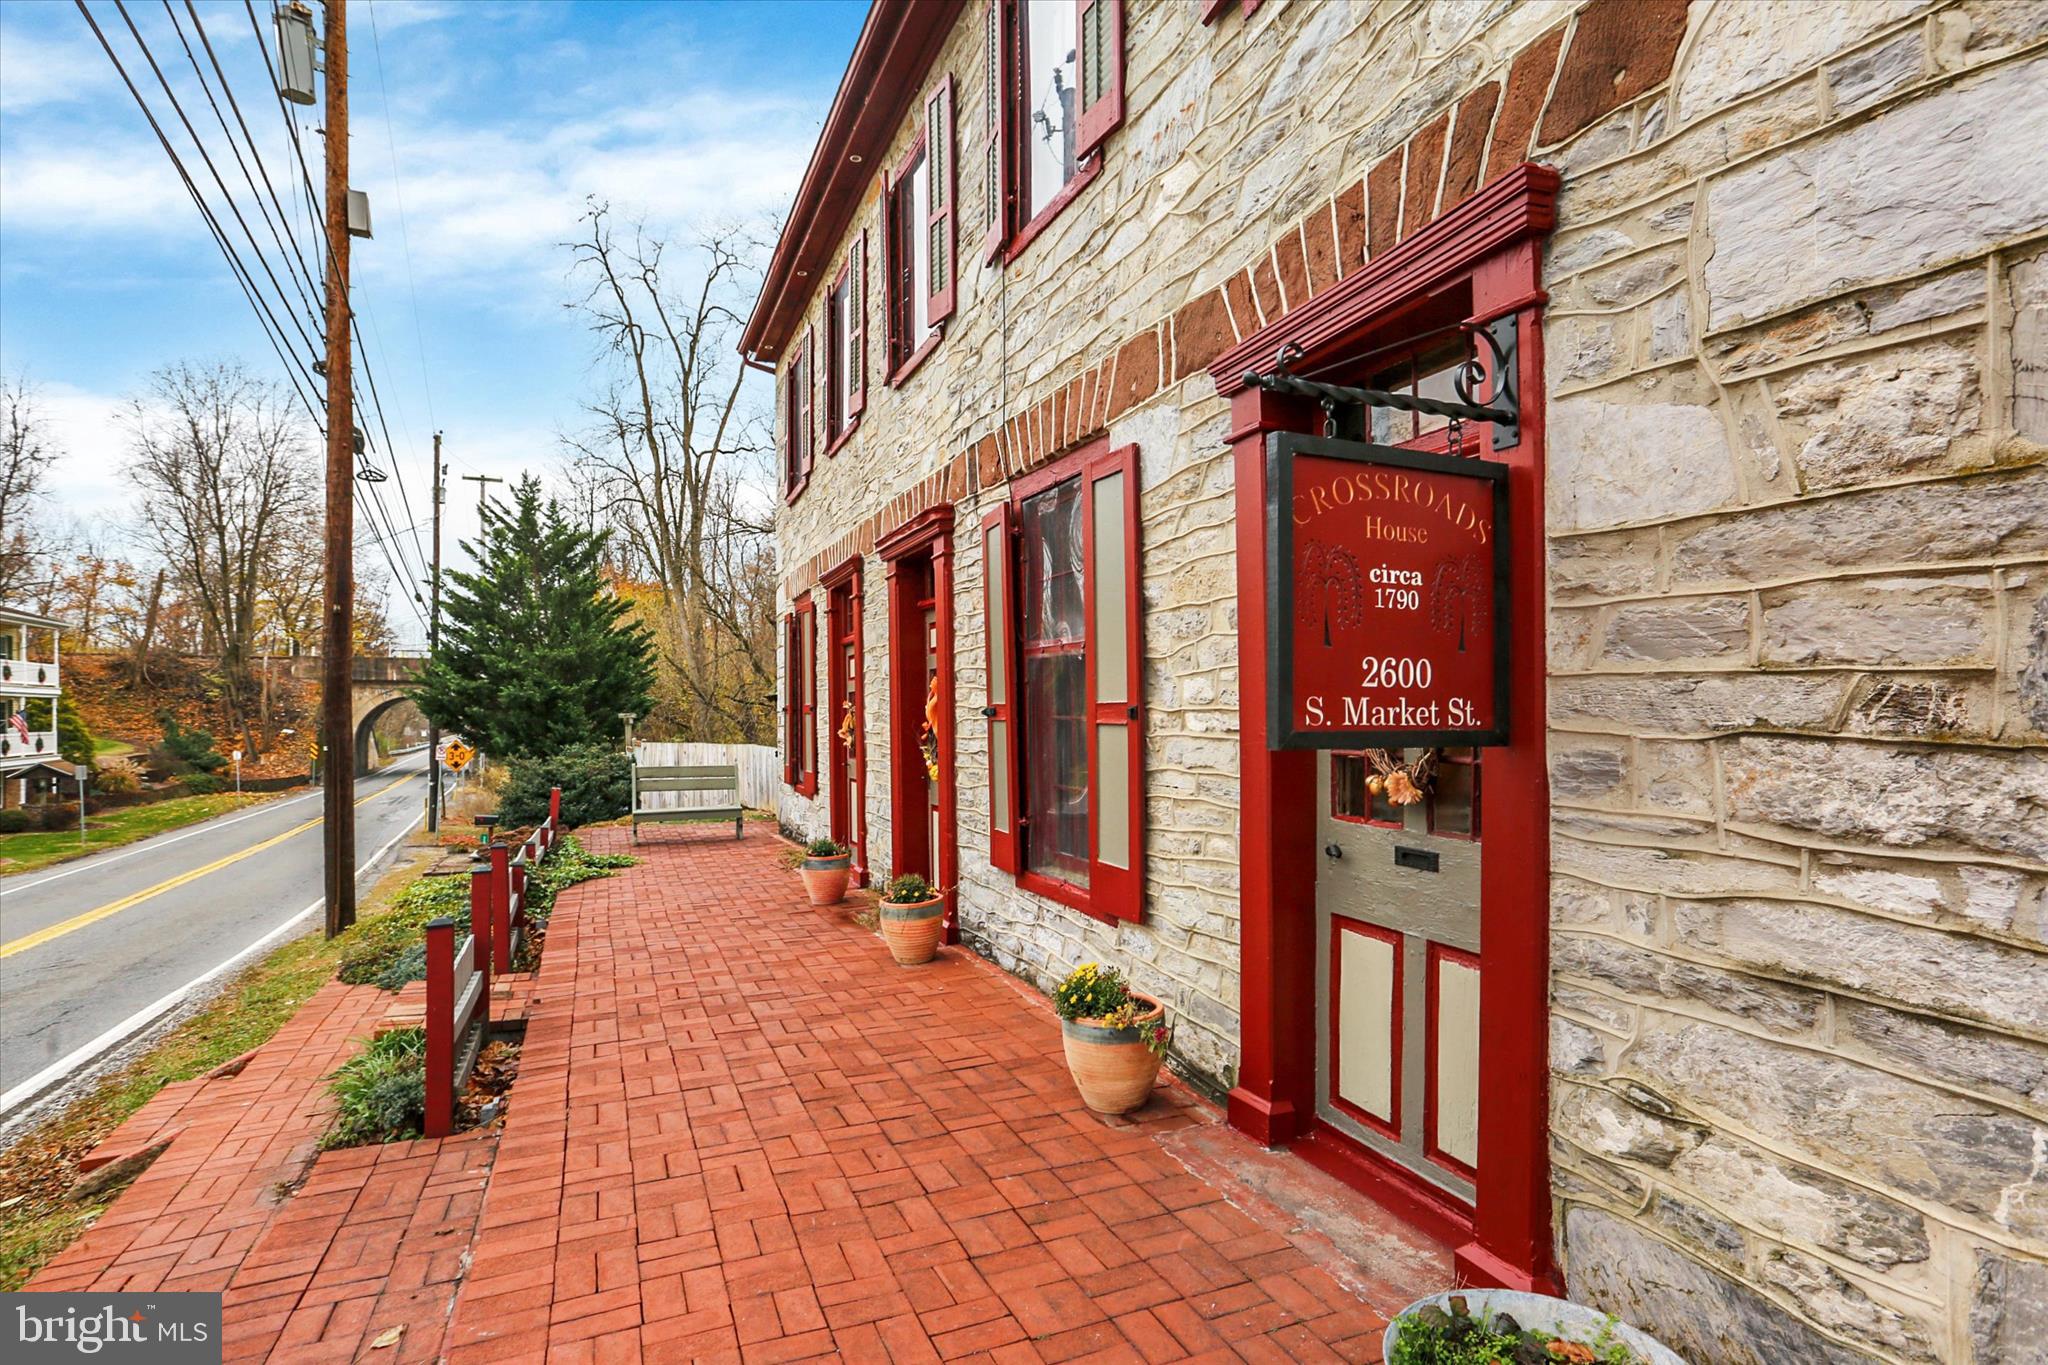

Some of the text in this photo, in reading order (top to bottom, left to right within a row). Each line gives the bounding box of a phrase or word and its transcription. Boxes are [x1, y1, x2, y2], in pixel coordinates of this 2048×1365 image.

[1293, 472, 1492, 544] CROSSROADS
[1366, 515, 1428, 544] House
[1369, 563, 1423, 586] circa
[1375, 588, 1419, 610] 1790
[1361, 656, 1432, 689] 2600
[1305, 695, 1482, 727] S. Market St.
